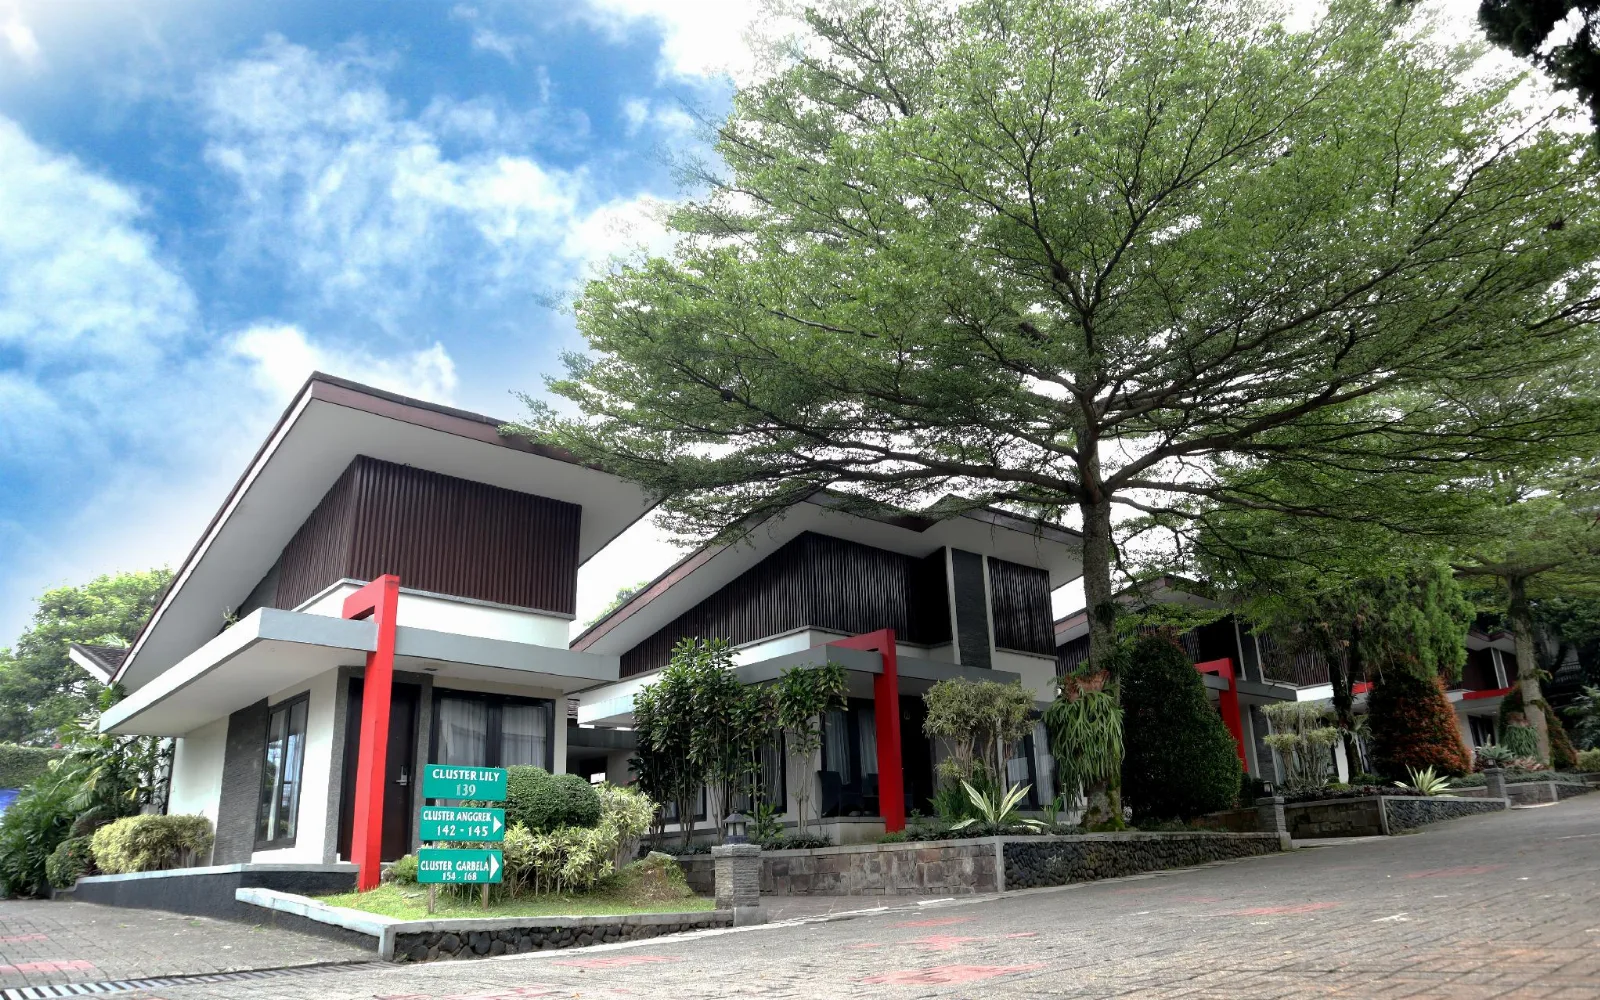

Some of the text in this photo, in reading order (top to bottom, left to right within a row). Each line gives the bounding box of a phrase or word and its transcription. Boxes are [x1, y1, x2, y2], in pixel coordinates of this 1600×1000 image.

[432, 769, 500, 782] CLUSTER LILY
[456, 784, 476, 796] 139
[423, 810, 492, 822] CLUSTER ANGGREK
[437, 825, 456, 836] 142
[468, 826, 488, 836] 145
[420, 860, 489, 871] CLUSTER GARBELA
[442, 872, 456, 881] 154
[464, 872, 477, 881] 168
